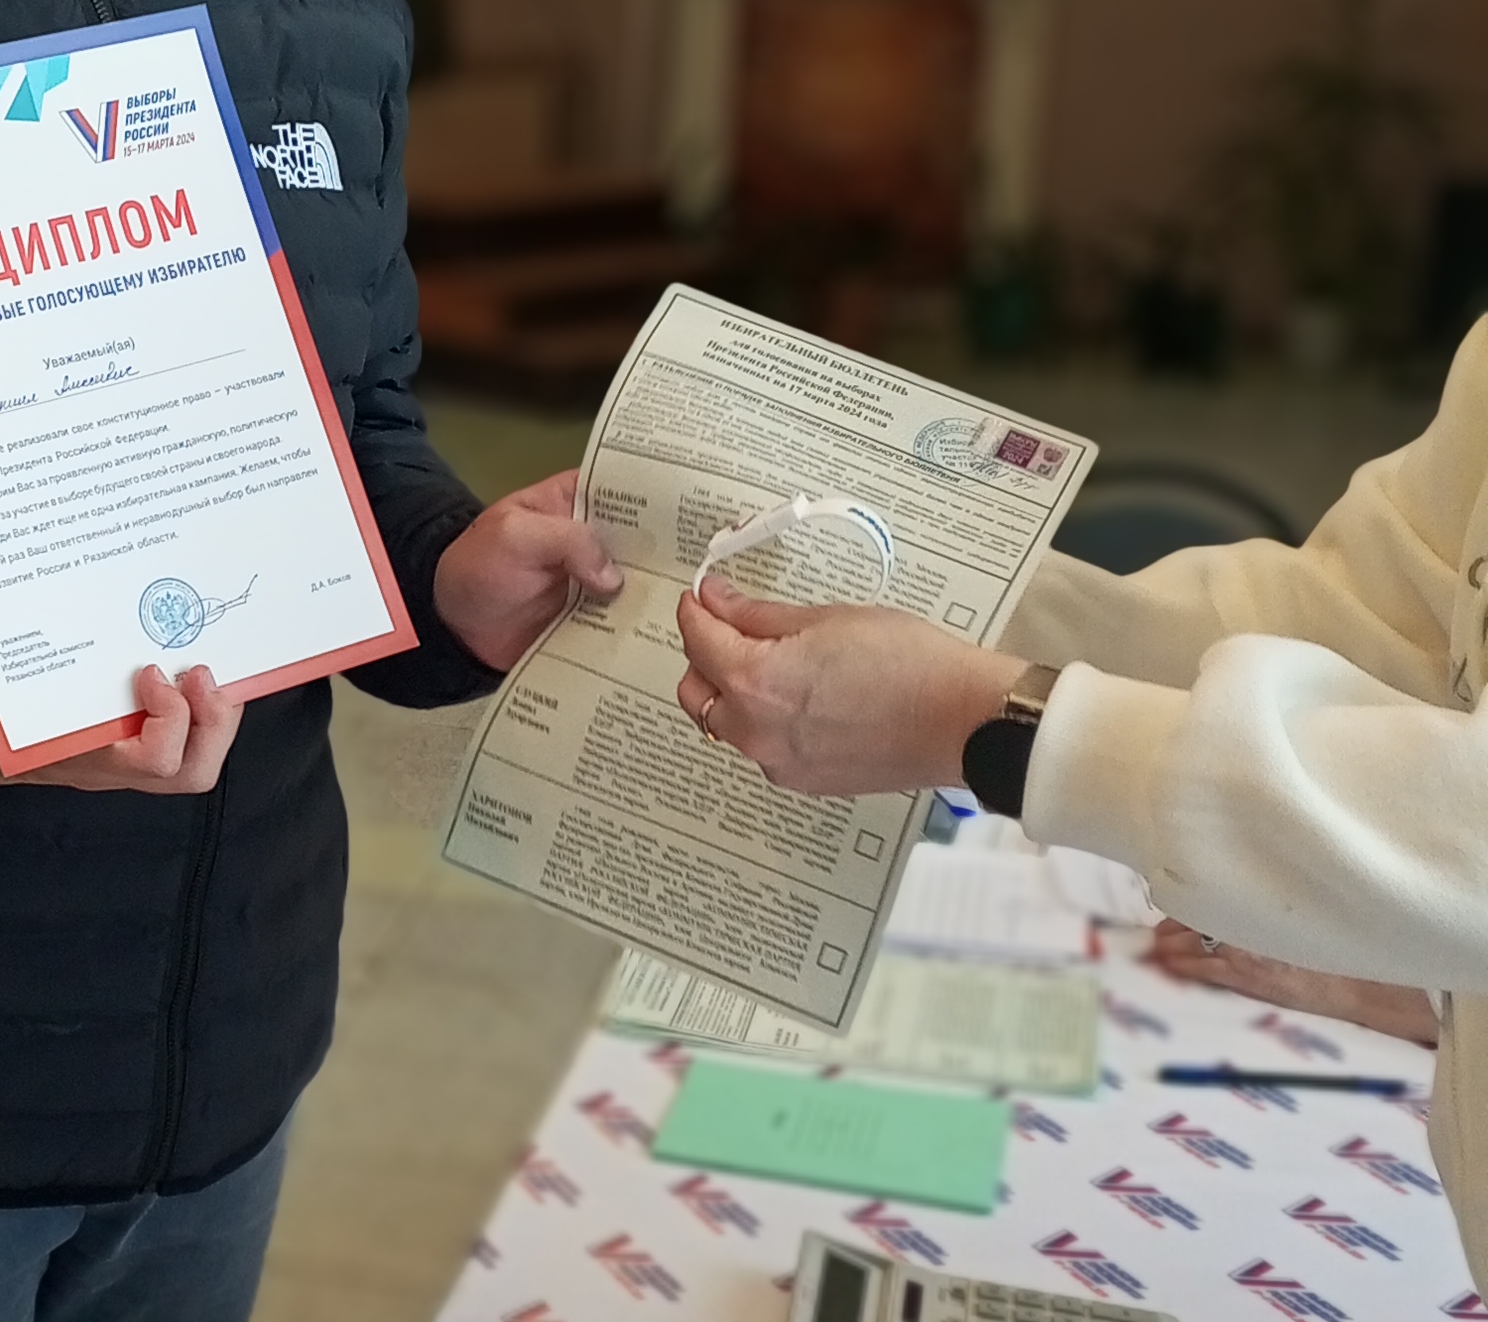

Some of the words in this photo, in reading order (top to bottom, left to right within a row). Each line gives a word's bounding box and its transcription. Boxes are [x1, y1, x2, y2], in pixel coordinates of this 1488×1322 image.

[125, 99, 196, 126] ПРЕЗИДЕНТА
[126, 87, 176, 110] ВЫБОРЫ
[124, 121, 169, 143] РОССИИ
[146, 136, 174, 152] МАРТА
[175, 131, 195, 146] 2024
[272, 122, 316, 149] THE
[249, 142, 316, 170] NORTH
[274, 164, 327, 190] FACE
[27, 271, 143, 314] ГОЛОСУЮЩЕМУ
[147, 246, 246, 284] ИЗБИРАТЕЛЮ
[42, 336, 135, 370] Уважаемый(ая)
[720, 319, 828, 365] ИЗБИРАТЕЛЬНЫЙ
[829, 359, 908, 396] БЮЛЛЕТЕНЬ
[768, 364, 831, 394] Российской
[835, 380, 881, 402] выборах
[6, 428, 69, 453] реализовали
[71, 421, 94, 434] свое
[96, 399, 180, 427] конституционное
[182, 390, 212, 405] право
[223, 370, 285, 395] участвовали
[789, 384, 803, 394] 17
[803, 390, 835, 408] марта
[836, 403, 862, 418] 2024
[16, 481, 35, 493] Вас
[36, 477, 48, 488] за
[48, 460, 113, 485] проявленную
[114, 447, 161, 466] активную
[161, 429, 230, 454] гражданскую,
[229, 409, 298, 434] политическую
[55, 437, 112, 461] Российской
[0, 510, 12, 520] за
[11, 500, 49, 519] участие
[50, 498, 57, 506] в
[57, 488, 93, 505] выборе
[93, 475, 140, 496] будущего
[140, 465, 169, 482] своей
[169, 457, 205, 474] страны
[205, 455, 212, 463] и
[212, 446, 245, 461] своего
[11, 526, 31, 538] Вас
[32, 519, 55, 533] ждет
[57, 514, 77, 526] еще
[77, 510, 90, 520] не
[90, 503, 115, 517] одна
[115, 483, 188, 510] избирательная
[280, 447, 311, 461] чтобы
[7, 551, 26, 565] раз
[26, 545, 48, 557] Ваш
[49, 521, 122, 551] ответственный
[123, 521, 130, 530] и
[131, 496, 211, 528] неравнодушный
[212, 489, 244, 505] выбор
[244, 482, 266, 495] был
[266, 468, 318, 488] направлен
[35, 561, 71, 577] России
[73, 559, 80, 567] и
[82, 541, 135, 565] Рязанской
[4, 665, 45, 684] Рязанской
[45, 658, 76, 672] области
